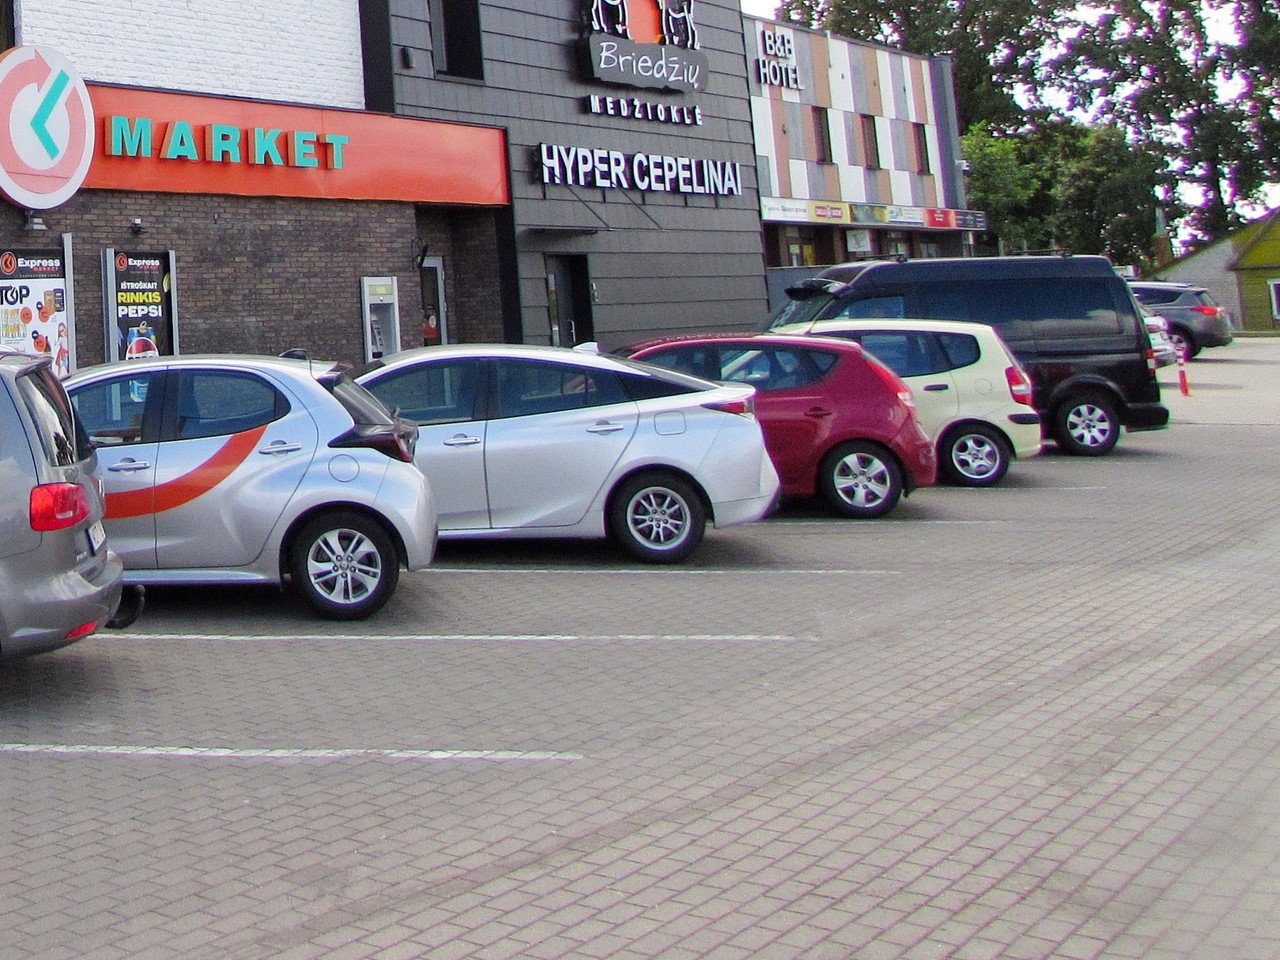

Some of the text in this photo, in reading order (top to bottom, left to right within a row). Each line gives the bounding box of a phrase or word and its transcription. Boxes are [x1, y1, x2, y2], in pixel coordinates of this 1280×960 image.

[765, 29, 795, 58] B&B
[600, 41, 700, 89] Briedžių
[759, 58, 805, 90] HOTEL
[590, 94, 703, 126] MEDŽIOKLĖ
[105, 115, 349, 169] MARKET
[540, 143, 742, 196] HYPER CEPELINAI
[17, 257, 61, 268] Express
[128, 258, 160, 267] Express
[0, 285, 30, 305] TOP
[117, 292, 162, 303] RINKIS
[118, 305, 162, 318] PEPSI
